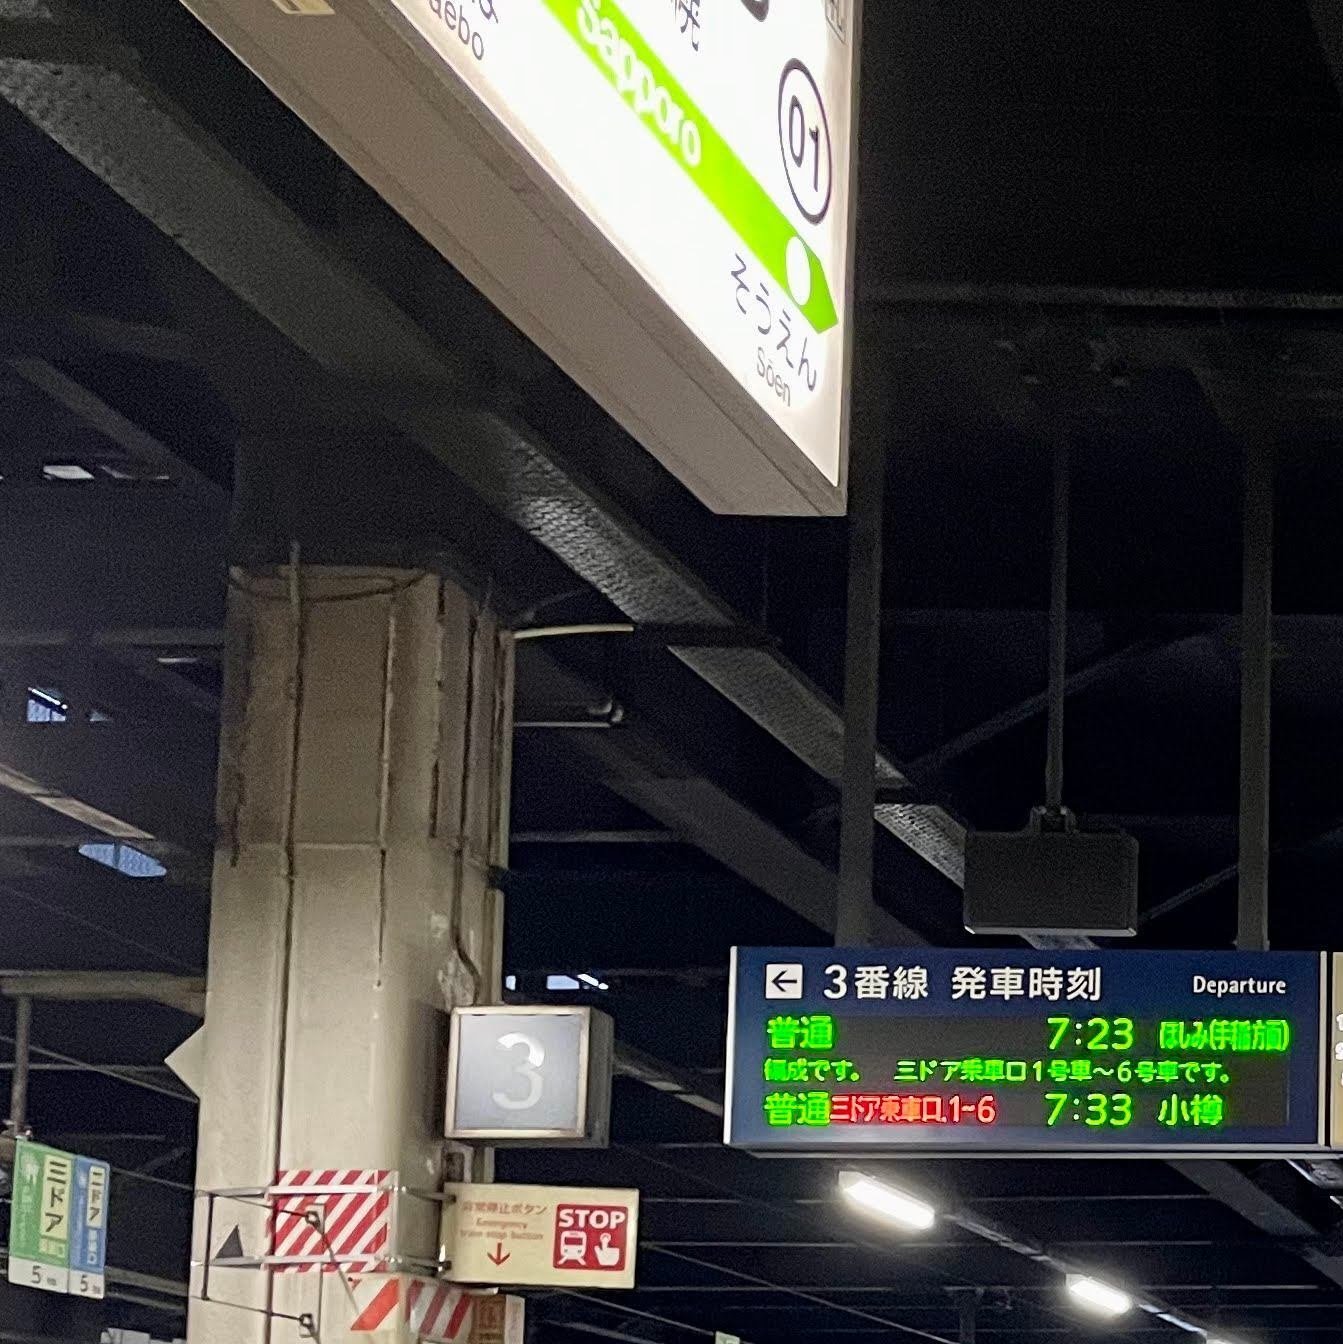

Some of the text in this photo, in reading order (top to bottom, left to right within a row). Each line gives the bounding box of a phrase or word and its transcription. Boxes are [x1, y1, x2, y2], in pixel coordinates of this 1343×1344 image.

[430, 0, 484, 60] aebo
[789, 95, 819, 192] 01
[730, 253, 818, 392] そうえん
[823, 964, 1102, 1001] 3番線 発車時刻
[1192, 975, 1287, 998] Departure
[766, 1015, 834, 1049] 普通
[1047, 1017, 1134, 1050] 7:23
[492, 1032, 545, 1110] 3
[764, 1091, 830, 1126] 普通
[1044, 1093, 1132, 1126] 7:33
[1157, 1093, 1223, 1126] 小樽
[558, 1208, 626, 1229] STOP
